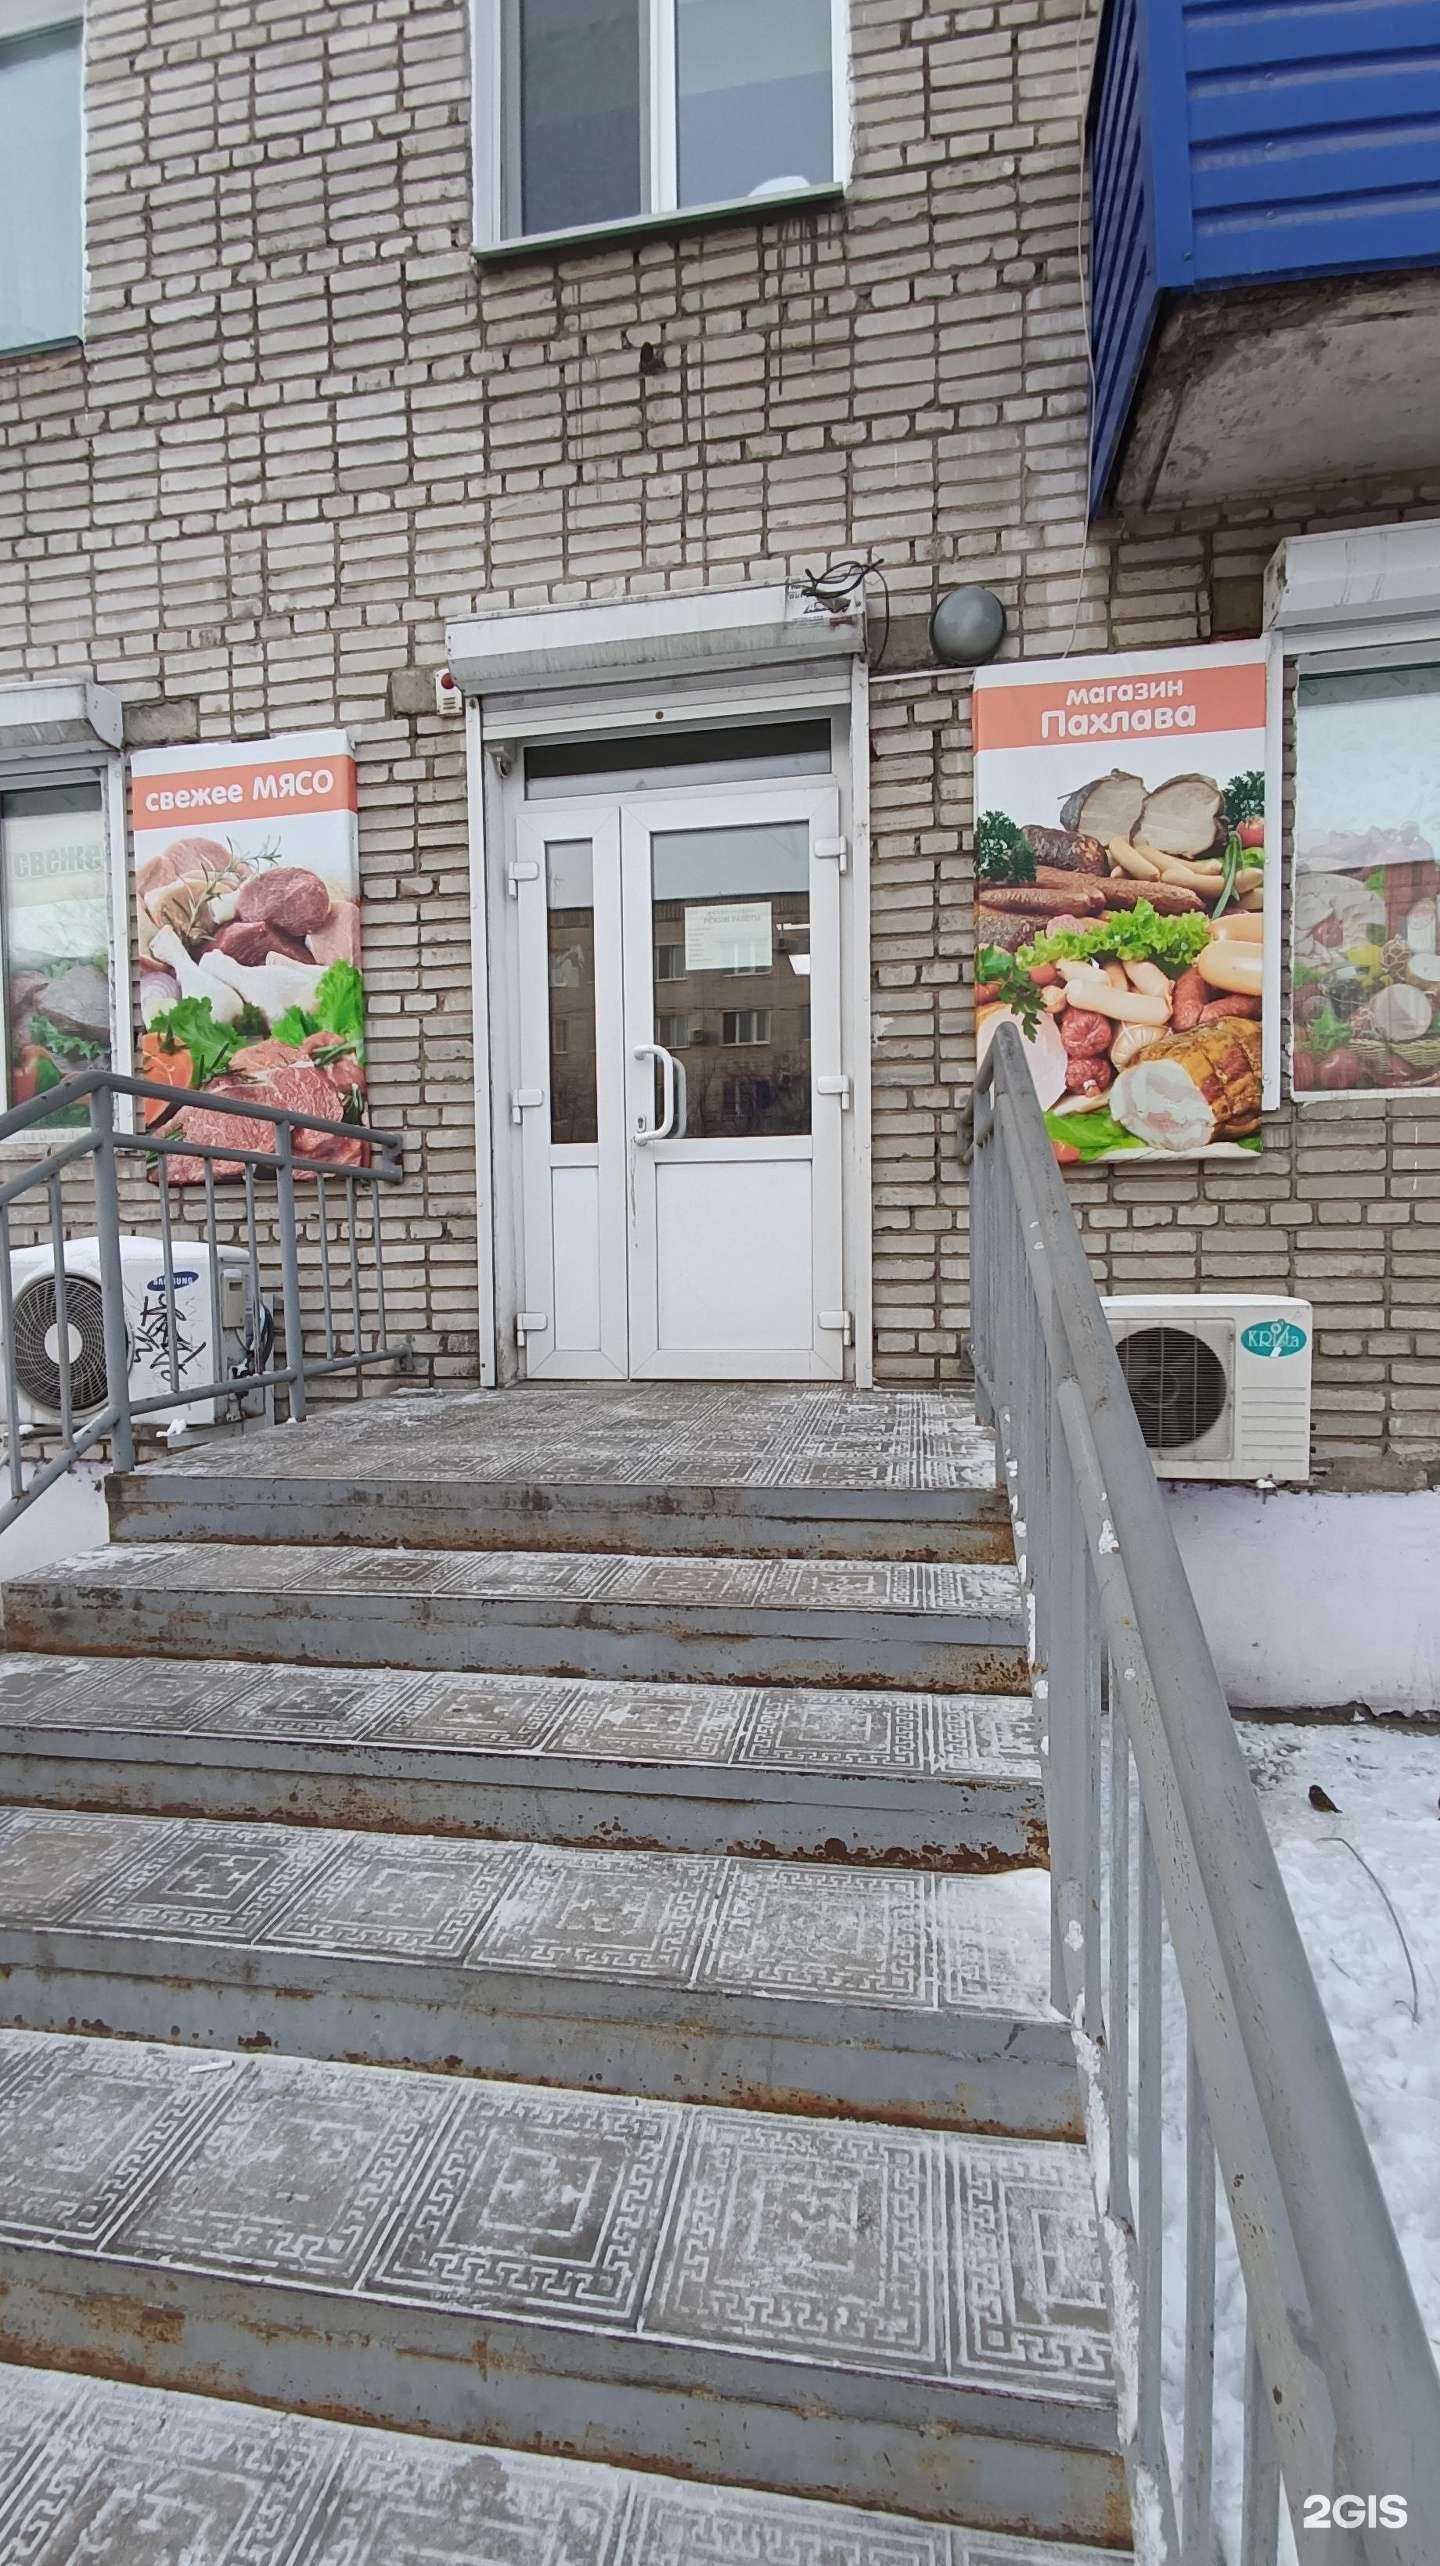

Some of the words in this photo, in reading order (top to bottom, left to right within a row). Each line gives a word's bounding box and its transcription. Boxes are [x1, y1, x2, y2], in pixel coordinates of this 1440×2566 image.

[1066, 679, 1184, 706] магазин
[1041, 705, 1197, 738] Пахлава
[145, 784, 244, 812] свежее
[252, 769, 334, 800] МЯСО
[153, 1276, 193, 1287] SAUNG
